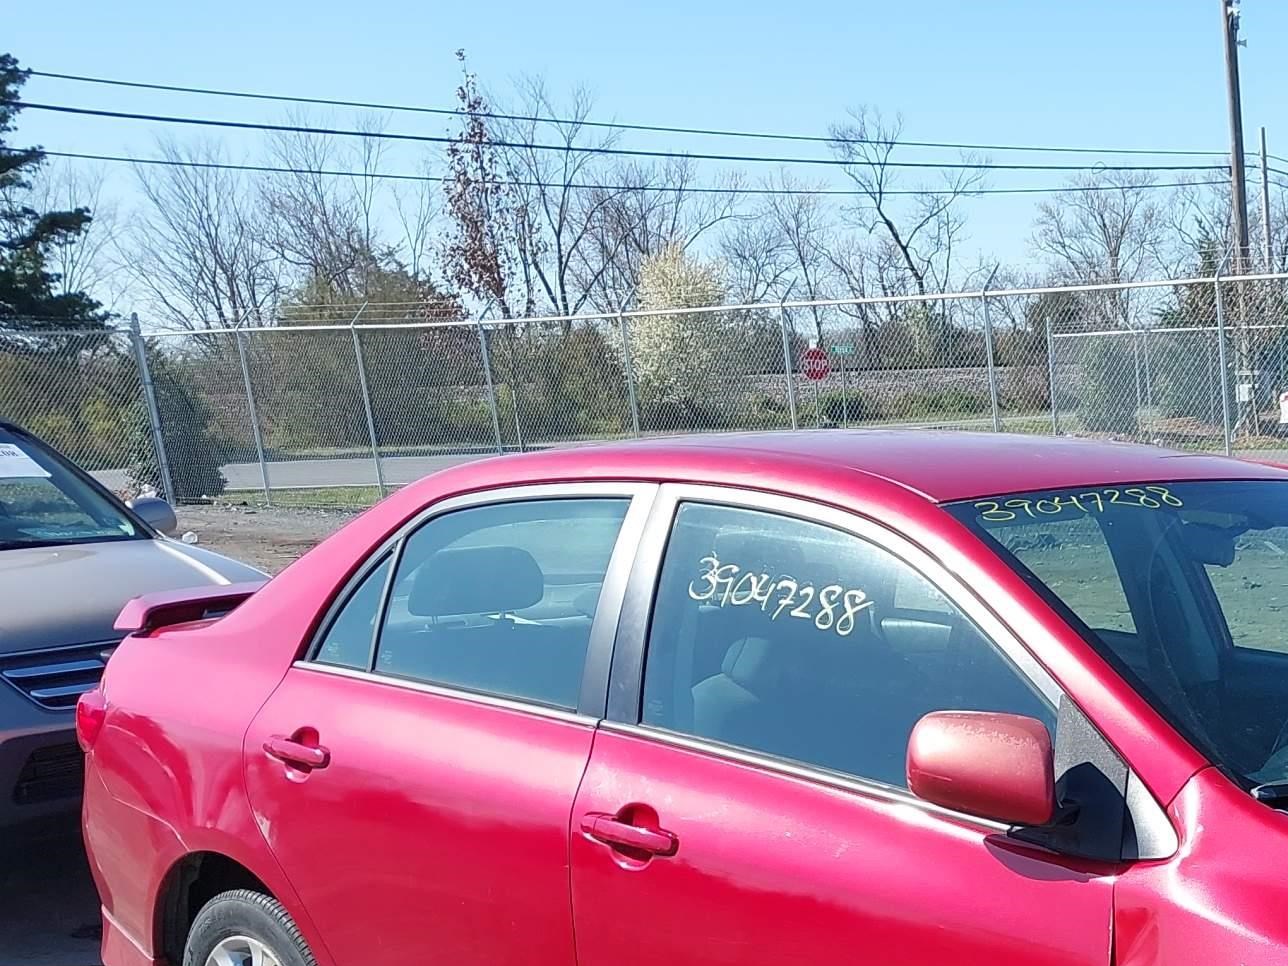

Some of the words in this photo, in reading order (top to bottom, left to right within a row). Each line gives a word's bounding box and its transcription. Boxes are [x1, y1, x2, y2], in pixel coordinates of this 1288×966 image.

[804, 359, 828, 371] STOP
[974, 486, 1183, 521] 39047288
[688, 551, 875, 636] 39047288
